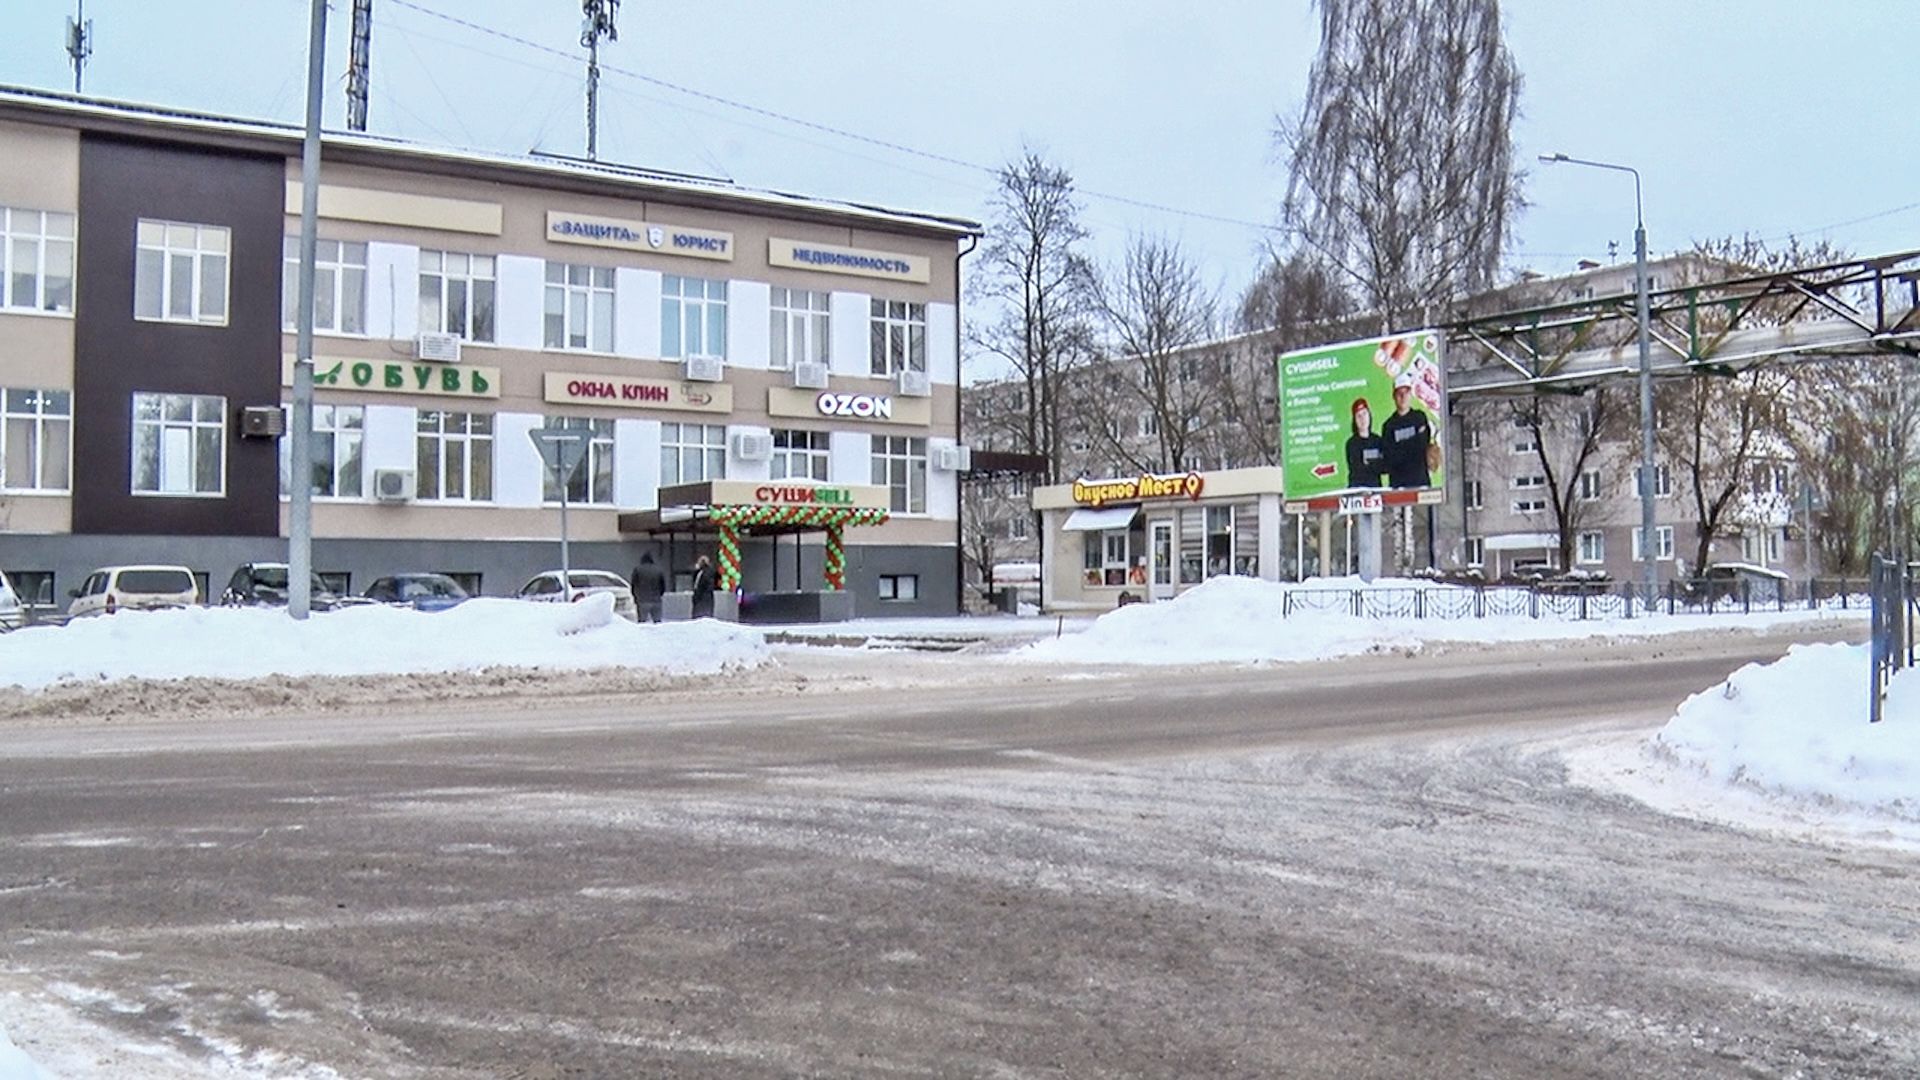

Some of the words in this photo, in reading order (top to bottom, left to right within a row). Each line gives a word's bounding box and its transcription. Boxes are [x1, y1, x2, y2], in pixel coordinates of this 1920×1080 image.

[552, 220, 640, 242] «ЗАЩИТА»
[672, 233, 728, 253] ЮРИСТ
[792, 248, 911, 274] НЕДВИЖИМОСТЬ
[352, 362, 489, 394] ОБУВЬ
[567, 380, 616, 399] ОКНА
[622, 383, 669, 403] КЛИН
[817, 393, 892, 419] OZON
[755, 486, 854, 504] СУШИSELL
